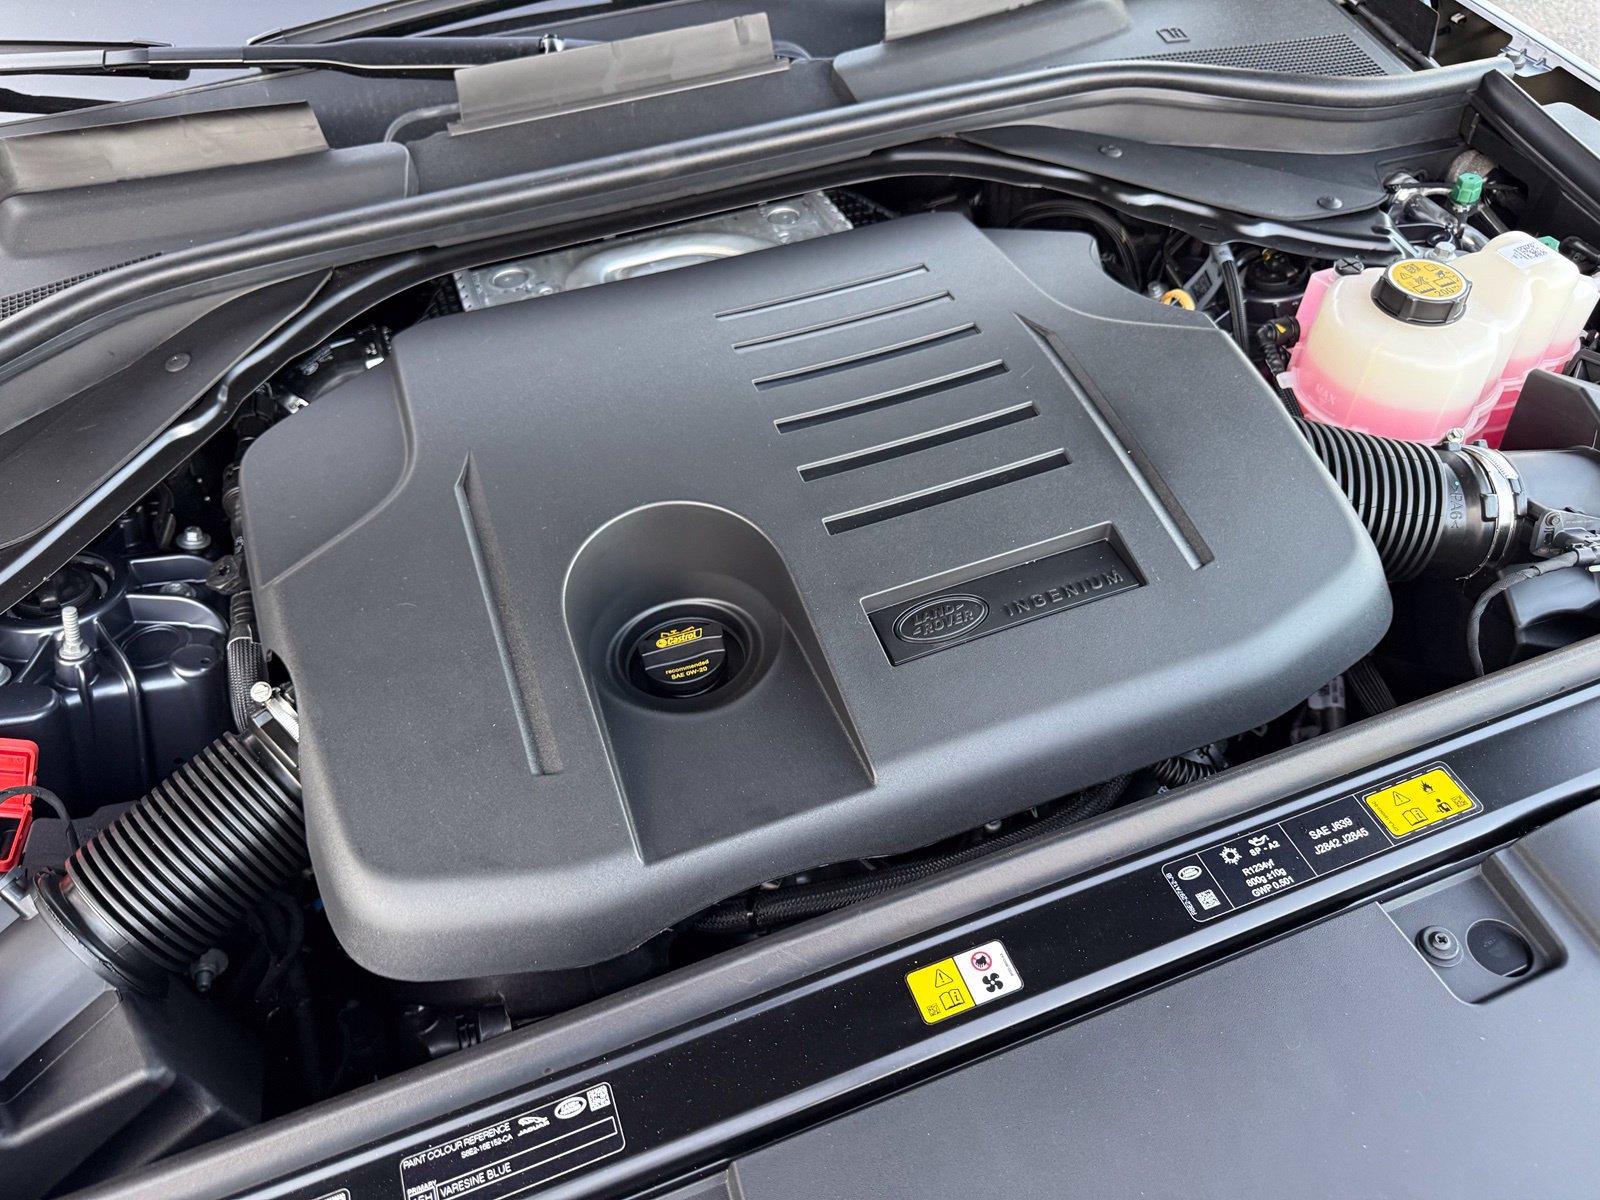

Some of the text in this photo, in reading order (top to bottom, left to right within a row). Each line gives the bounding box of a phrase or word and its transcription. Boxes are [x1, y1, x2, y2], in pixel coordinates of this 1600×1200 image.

[1002, 569, 1124, 618] INGENIUM
[913, 604, 956, 626] LAND
[923, 609, 975, 636] ROVER
[667, 631, 696, 646] Castrol
[665, 659, 710, 675] recommended
[671, 666, 708, 680] SAE 0W-20
[1308, 817, 1353, 840] SAE J639
[1267, 840, 1281, 851] A2
[1314, 827, 1369, 855] J2842 J2845
[1241, 858, 1275, 877] R1234yf
[1245, 867, 1287, 887] 800g ±10g
[1251, 875, 1295, 897] GWP 0.501
[517, 1120, 551, 1137] JAGUAR
[403, 1122, 511, 1170] PAINT COLOUR REFERENCE
[406, 1179, 437, 1195] PRIMARY
[439, 1172, 486, 1198] VARESINE
[486, 1162, 512, 1181] BLUE
